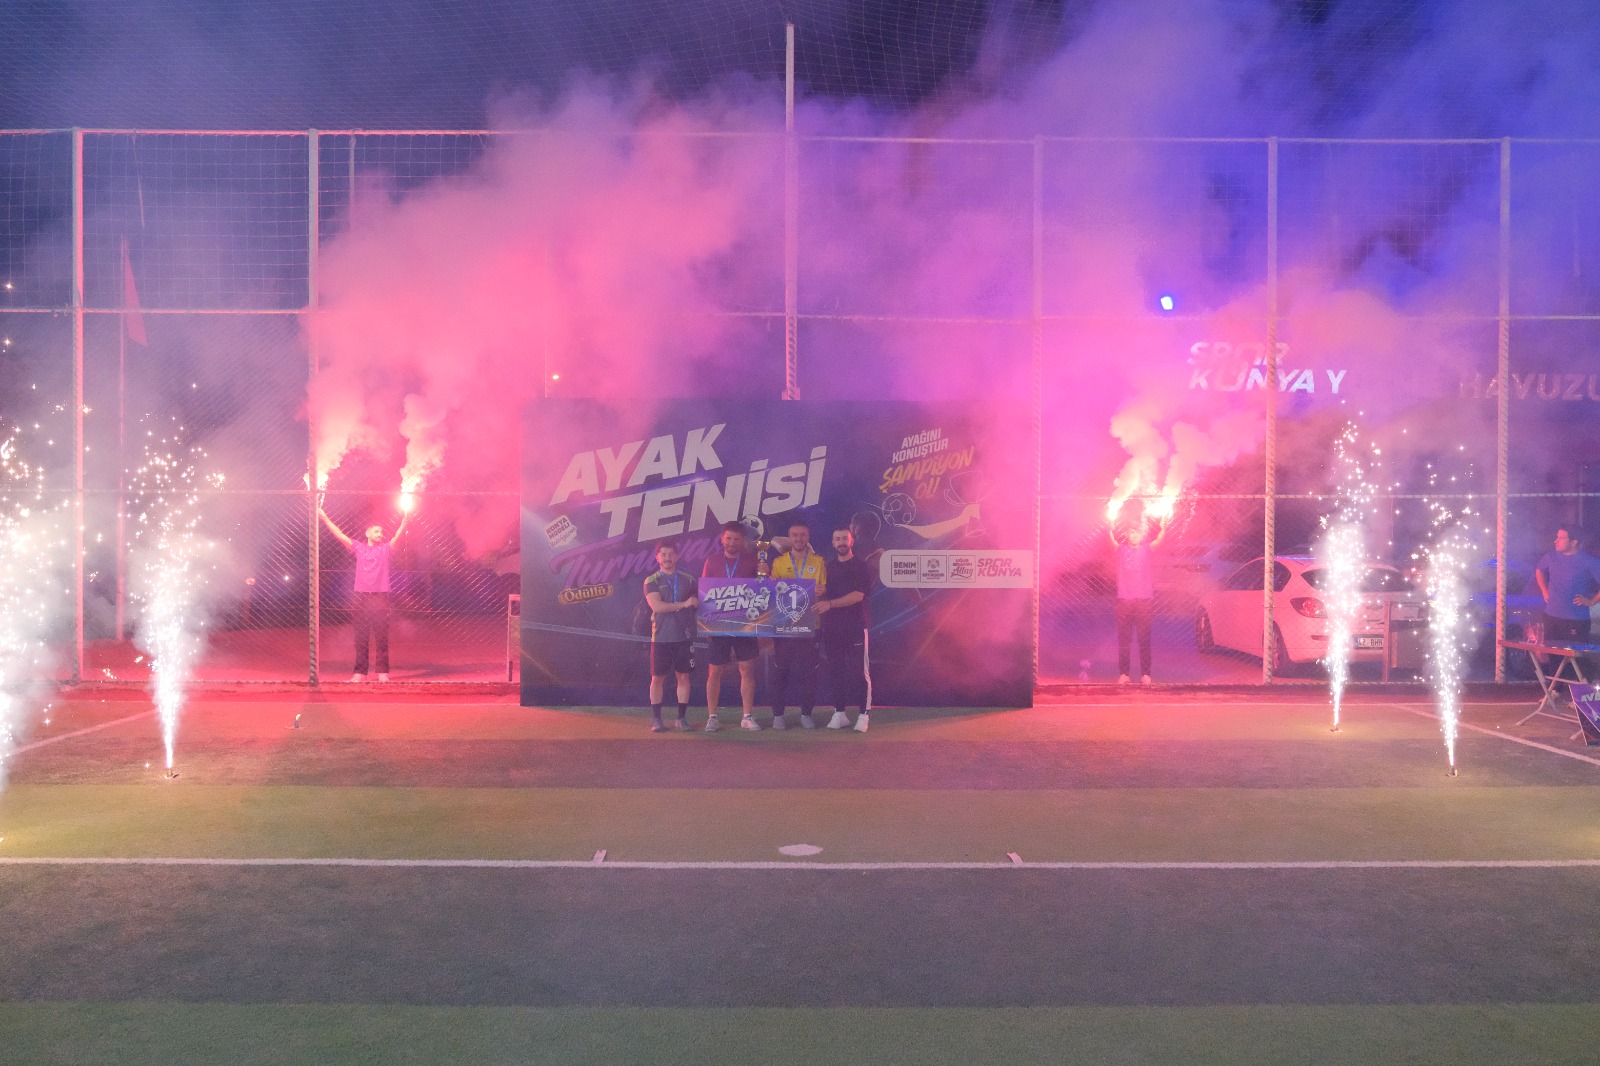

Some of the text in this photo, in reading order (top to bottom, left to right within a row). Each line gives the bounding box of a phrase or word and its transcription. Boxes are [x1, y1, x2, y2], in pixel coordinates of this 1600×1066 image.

[901, 427, 942, 450] AYAĞINI
[892, 438, 949, 464] KONUŞTUR
[548, 423, 727, 507] AYAK
[600, 445, 827, 543] TENİSİ
[546, 517, 568, 535] KONYA
[893, 561, 917, 569] BENİM
[977, 565, 1022, 577] KONYA
[563, 584, 607, 602] Ödüllü
[703, 583, 747, 602] AYAK
[788, 590, 797, 610] 1
